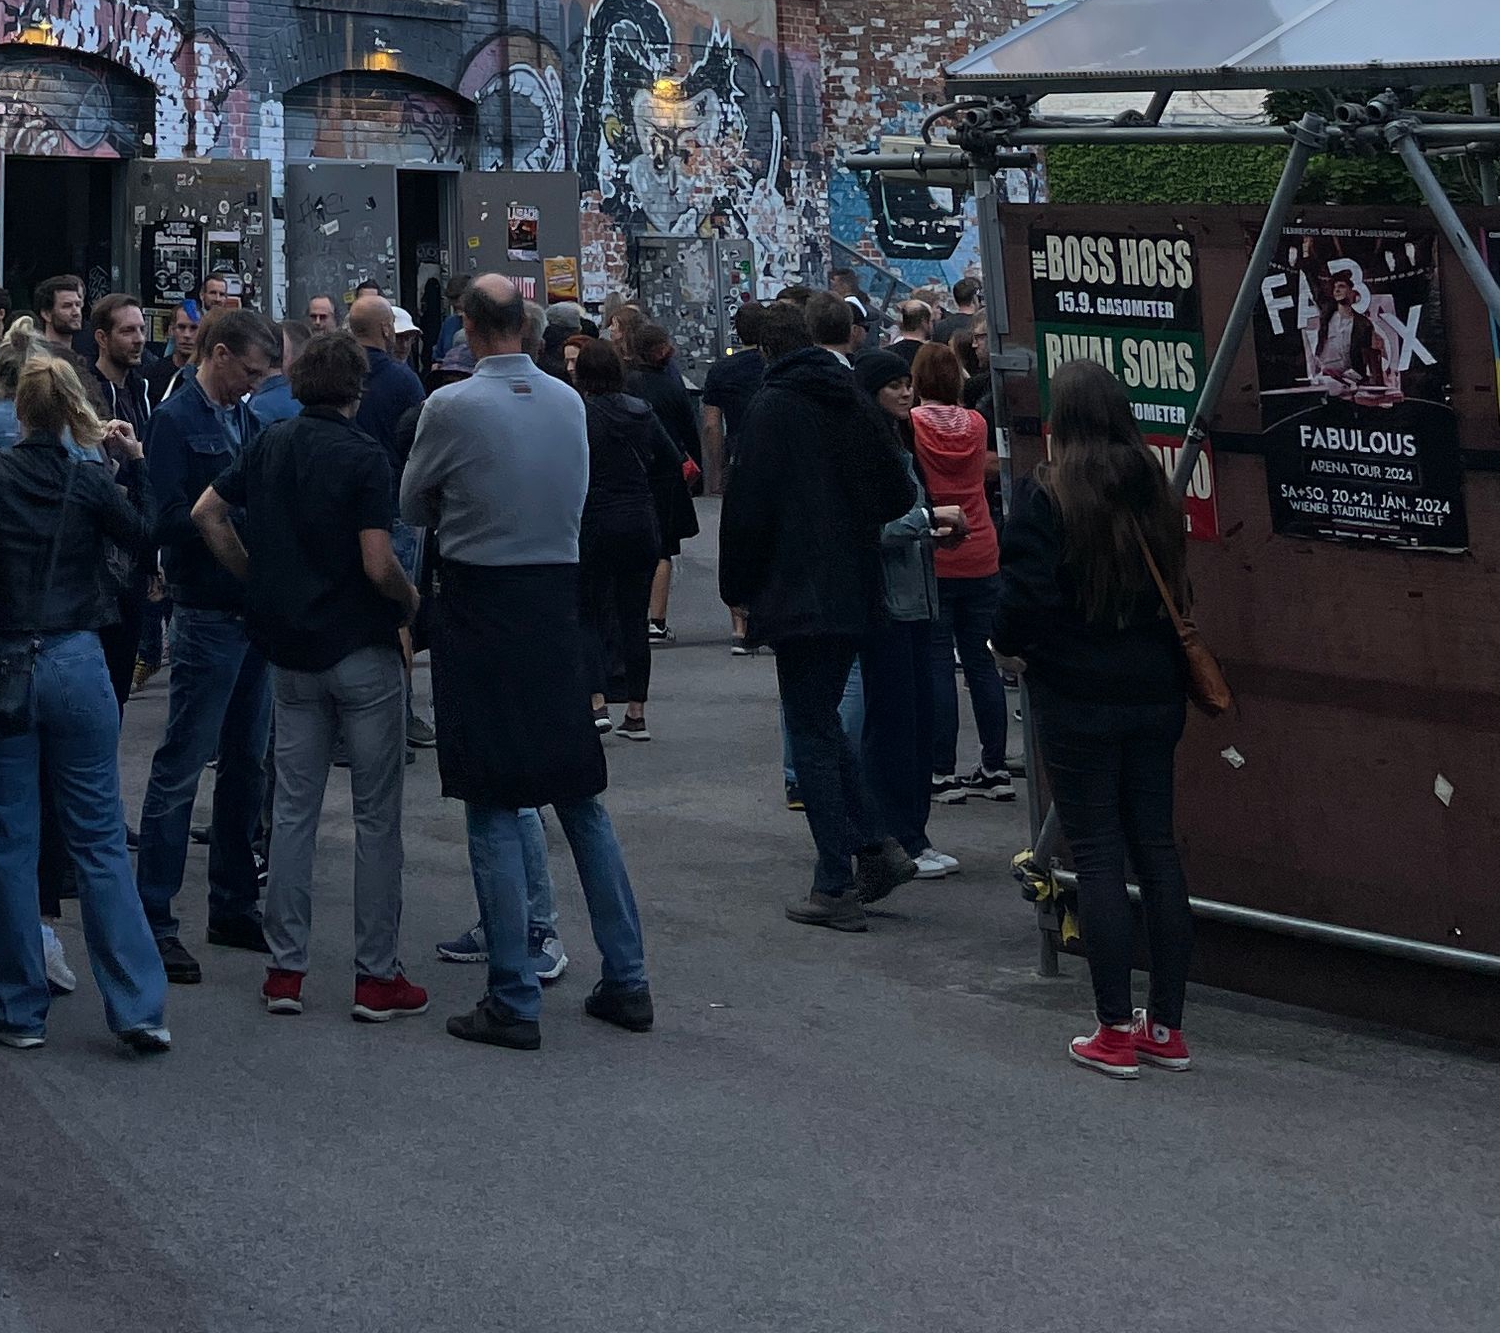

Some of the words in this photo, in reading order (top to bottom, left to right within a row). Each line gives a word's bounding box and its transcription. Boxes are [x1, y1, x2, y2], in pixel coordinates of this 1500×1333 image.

[1032, 250, 1047, 279] THE
[1046, 235, 1116, 284] BOSS
[1119, 238, 1193, 289] HOSS
[1055, 290, 1094, 314] 15.9.
[1096, 297, 1175, 319] GASOMETER
[1121, 337, 1196, 392] SONS
[1300, 425, 1417, 457] FABULOUS
[1311, 459, 1350, 475] ARENA
[1351, 463, 1381, 478] TOUR
[1384, 467, 1413, 482] 2024
[1289, 499, 1330, 515] WIENER
[1332, 504, 1391, 522] STADTHALLE
[1402, 512, 1436, 526] HALLE
[1415, 498, 1451, 514] 2024
